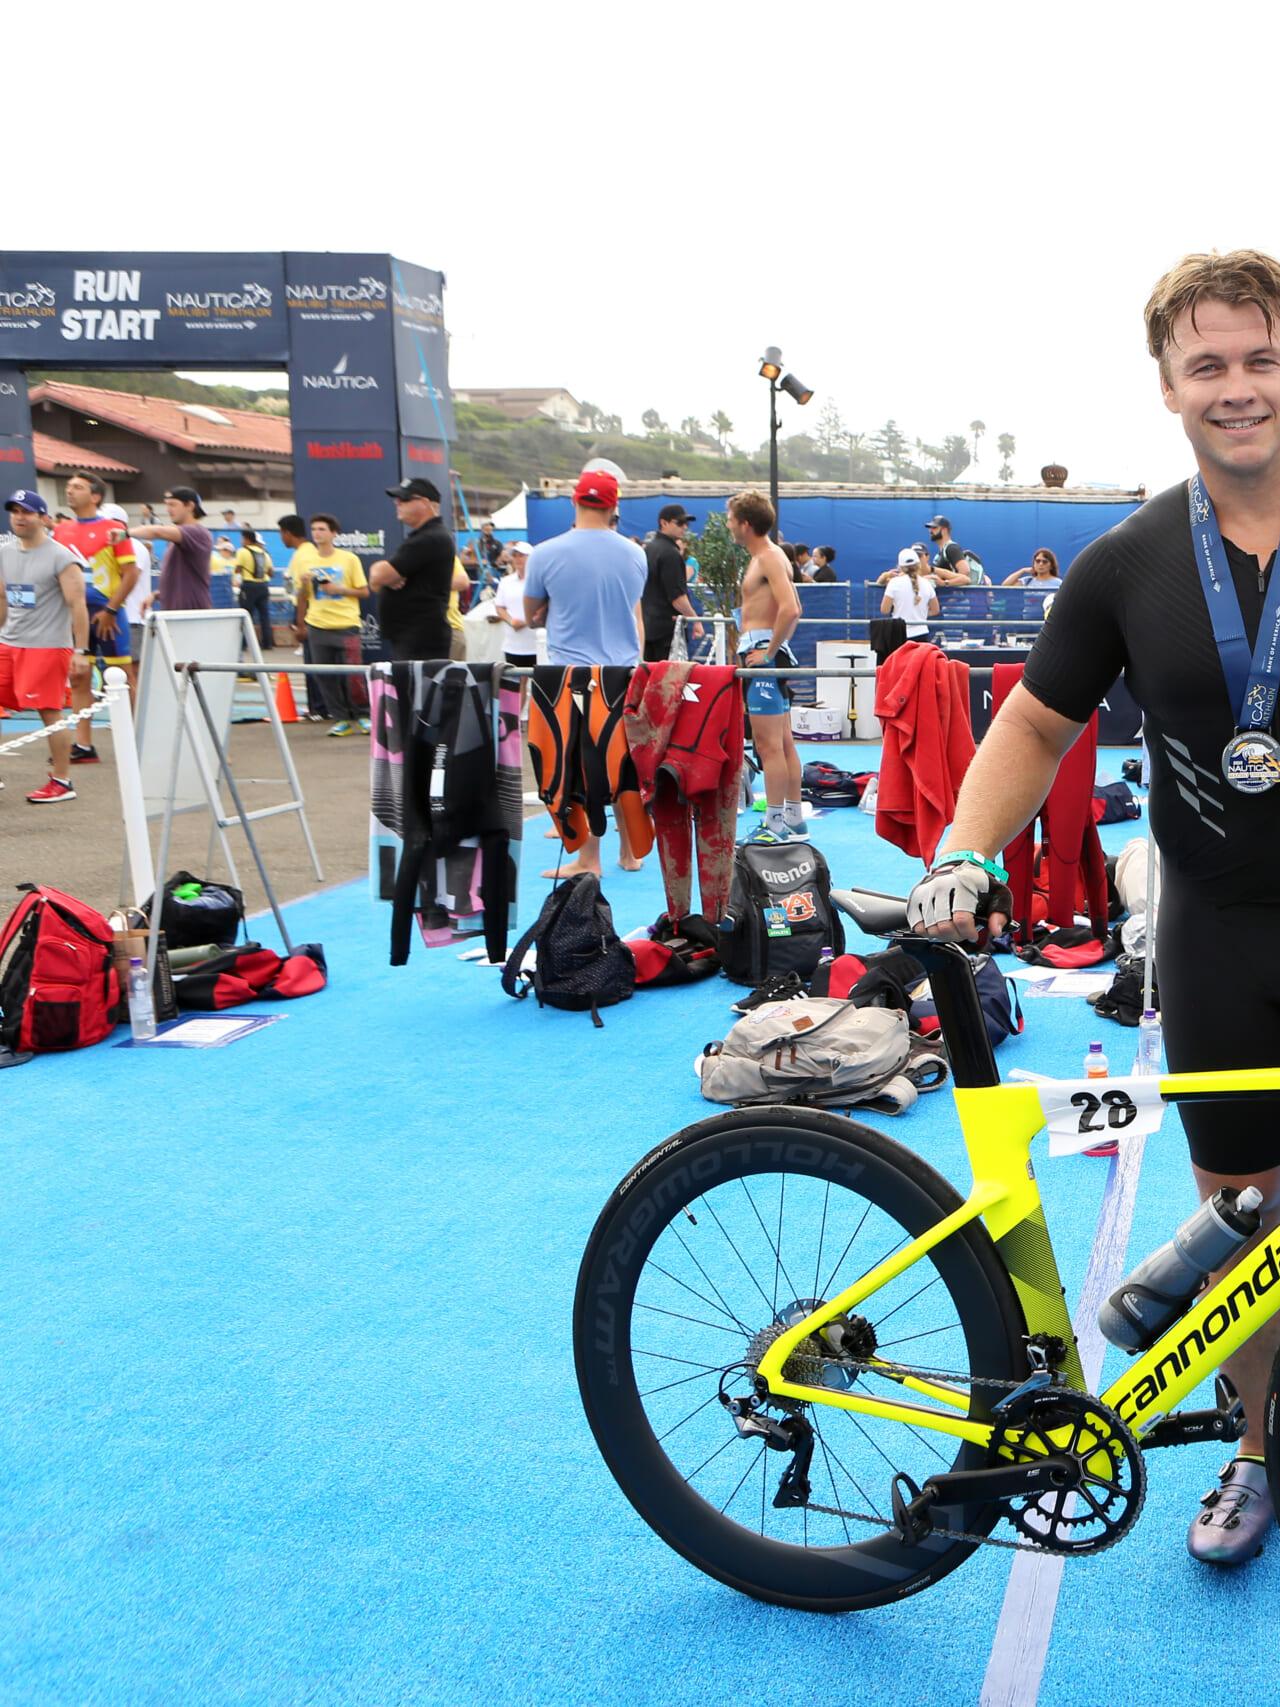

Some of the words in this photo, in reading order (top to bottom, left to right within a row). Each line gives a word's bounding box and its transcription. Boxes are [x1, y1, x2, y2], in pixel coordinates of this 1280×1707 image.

[74, 270, 141, 302] RUN
[285, 284, 372, 300] NAUTICA
[166, 292, 256, 308] NAUTICA
[60, 308, 161, 341] START
[303, 375, 379, 389] NAUTICA
[1266, 657, 1274, 673] BANK
[1271, 618, 1280, 647] AMERICA
[1228, 764, 1267, 772] NAUTICA
[761, 861, 812, 884] arena
[1070, 1089, 1138, 1133] 28
[619, 1138, 683, 1196] CONTINENTAL
